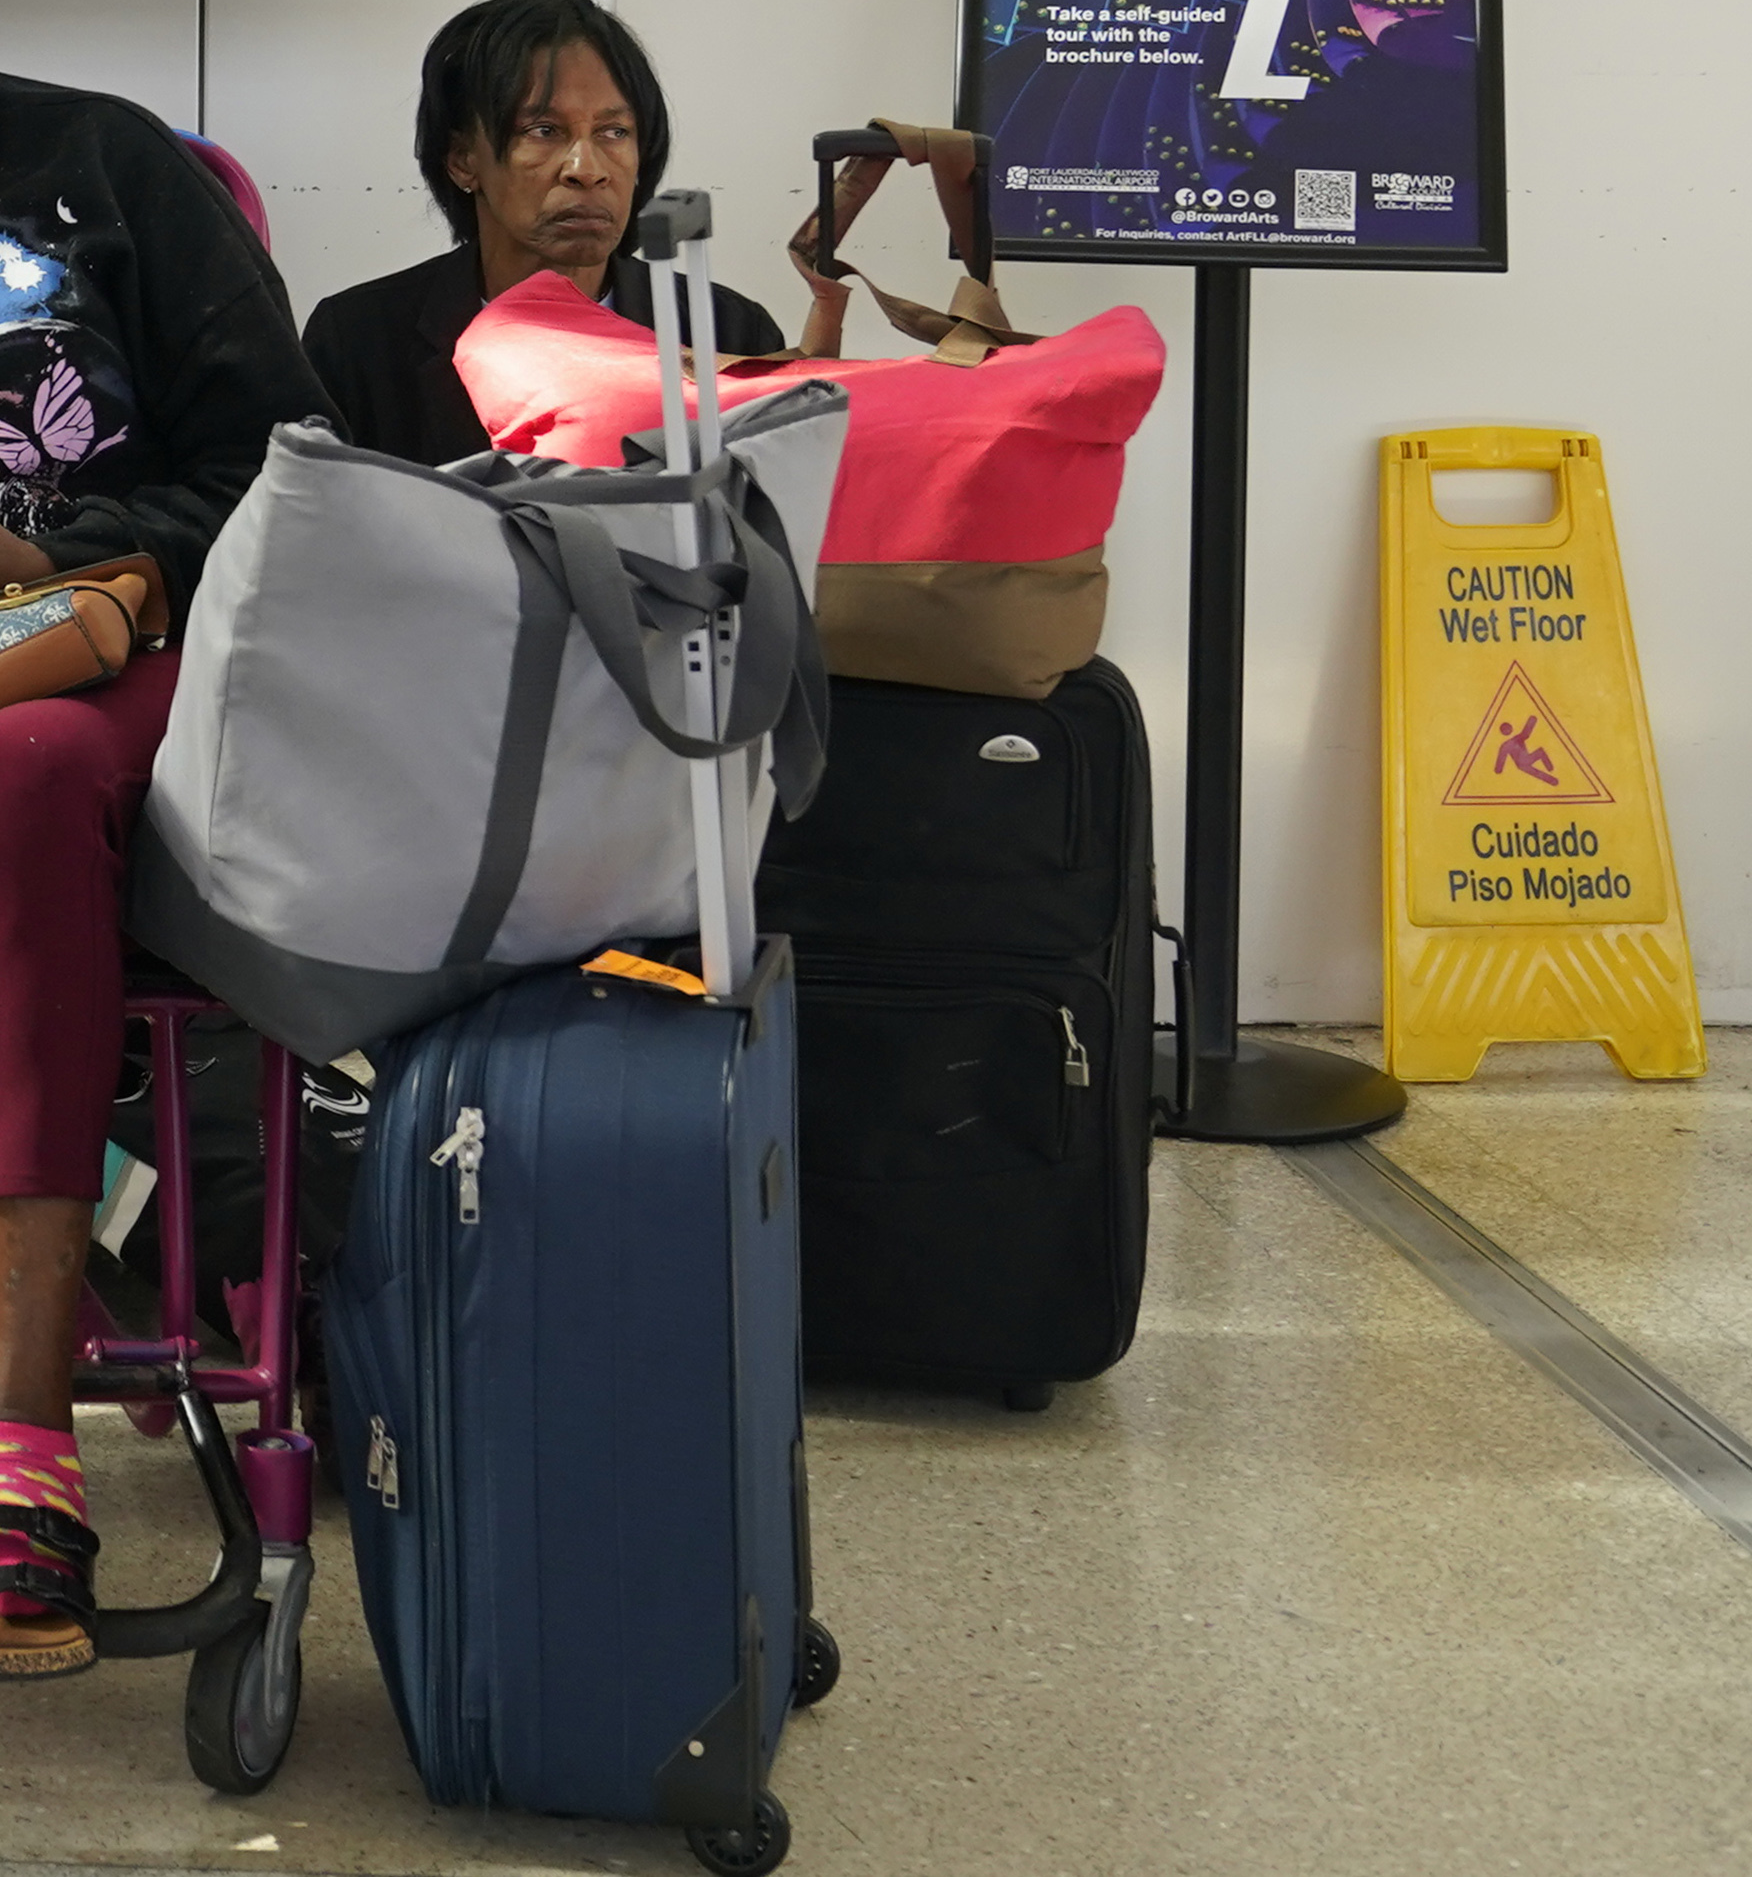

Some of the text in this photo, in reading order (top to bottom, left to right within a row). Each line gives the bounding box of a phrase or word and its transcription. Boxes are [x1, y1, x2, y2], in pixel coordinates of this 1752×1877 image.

[1047, 5, 1225, 26] Take a self-guided
[1046, 26, 1173, 44] tour with the
[1047, 48, 1203, 63] brochure below.
[1030, 168, 1159, 177] FORT LAUDERDALE-HOLLYWOOD
[1030, 175, 1160, 187] INTERNATIONAL AIRPORT
[1410, 187, 1453, 196] COUNTY
[1171, 212, 1280, 226] @BrowardArts
[1096, 227, 1355, 244] For inquiries, contact ArtFLL@broward.org
[1448, 565, 1573, 601] CAUTION
[1439, 605, 1586, 643] Wet Floor
[1472, 822, 1598, 858] Cuidado
[1449, 867, 1630, 908] Piso Mojado
